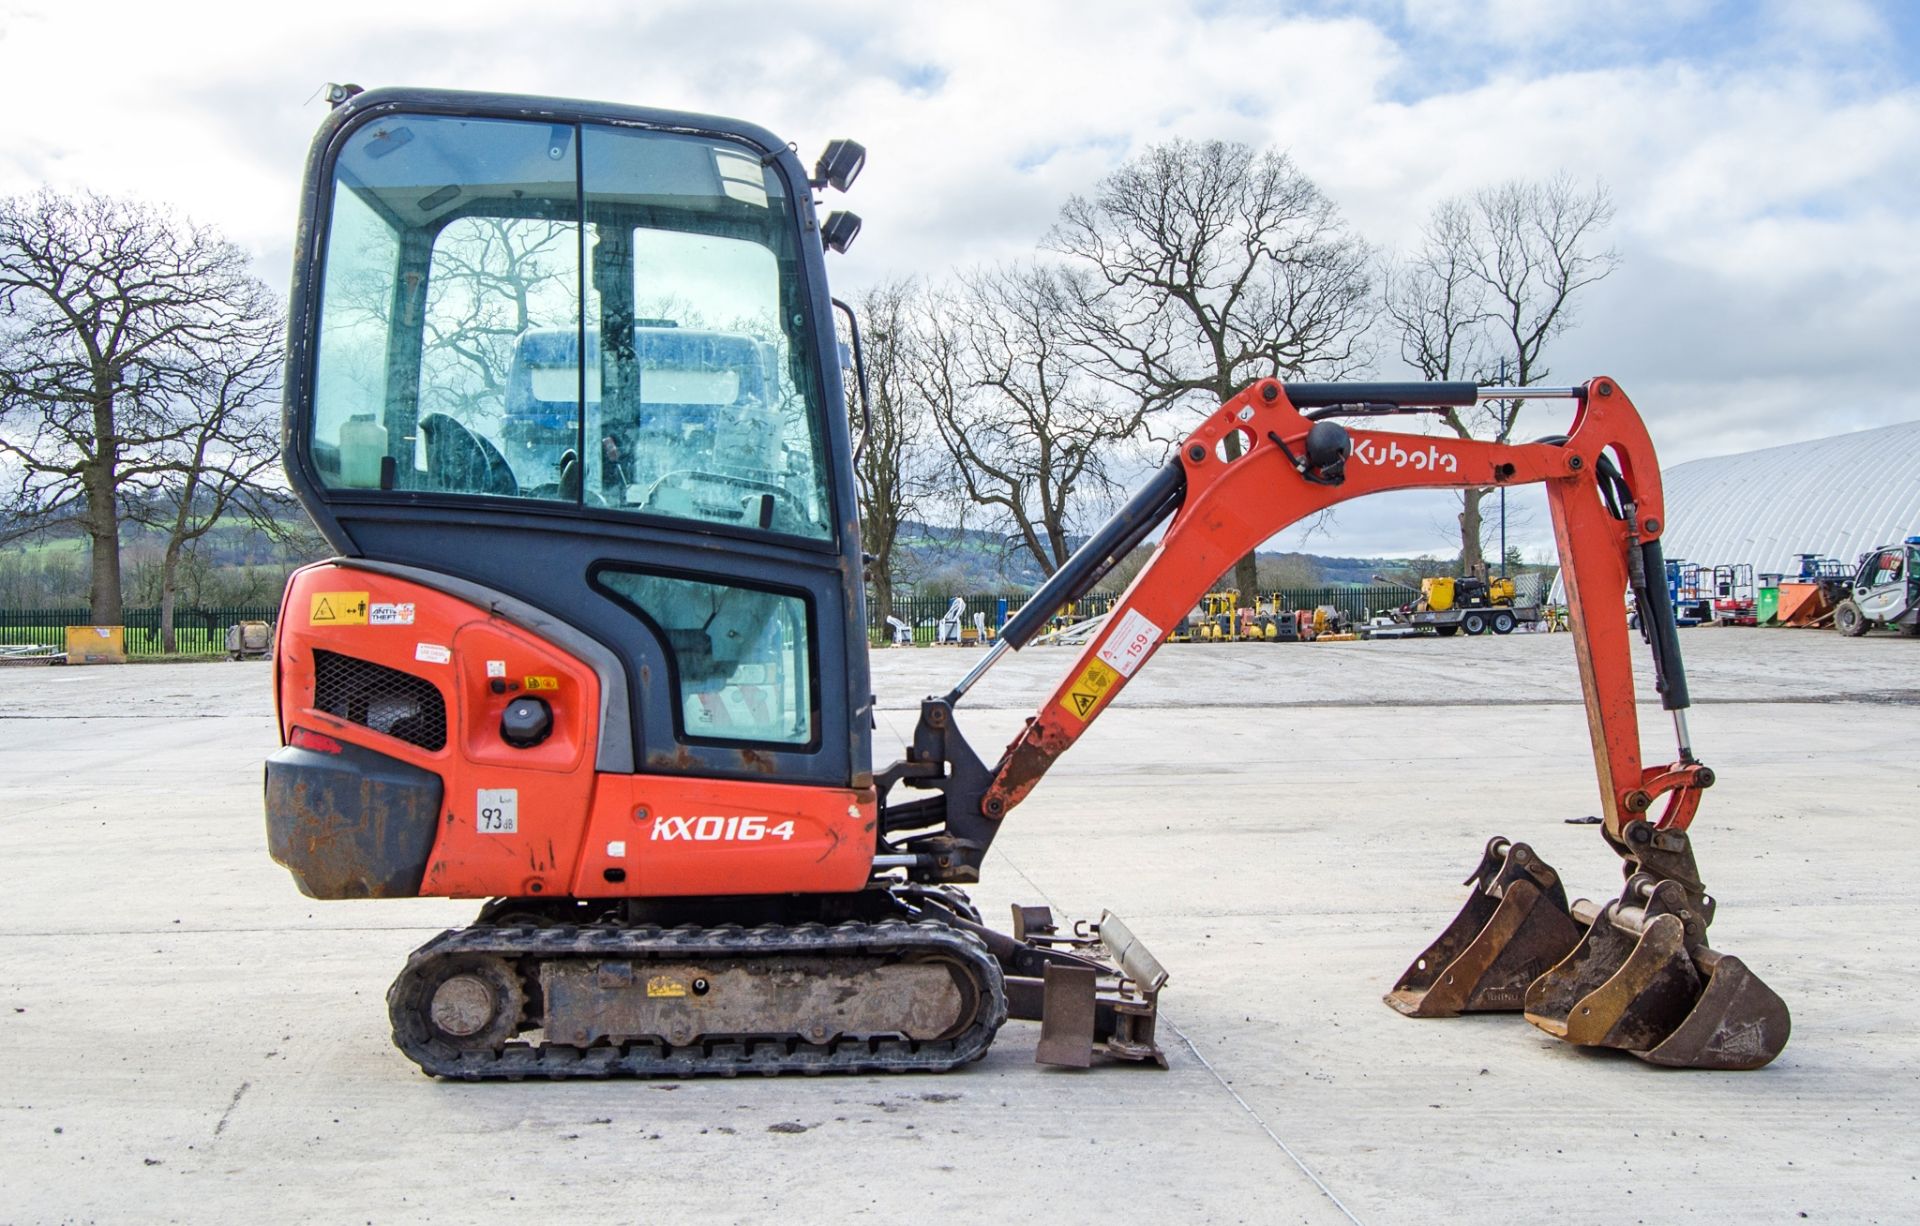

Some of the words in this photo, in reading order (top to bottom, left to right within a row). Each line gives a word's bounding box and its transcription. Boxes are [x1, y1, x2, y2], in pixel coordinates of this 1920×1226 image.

[1350, 438, 1457, 473] Kubota
[1126, 634, 1148, 657] 159
[481, 808, 502, 830] 93
[651, 816, 795, 841] KX016-4
